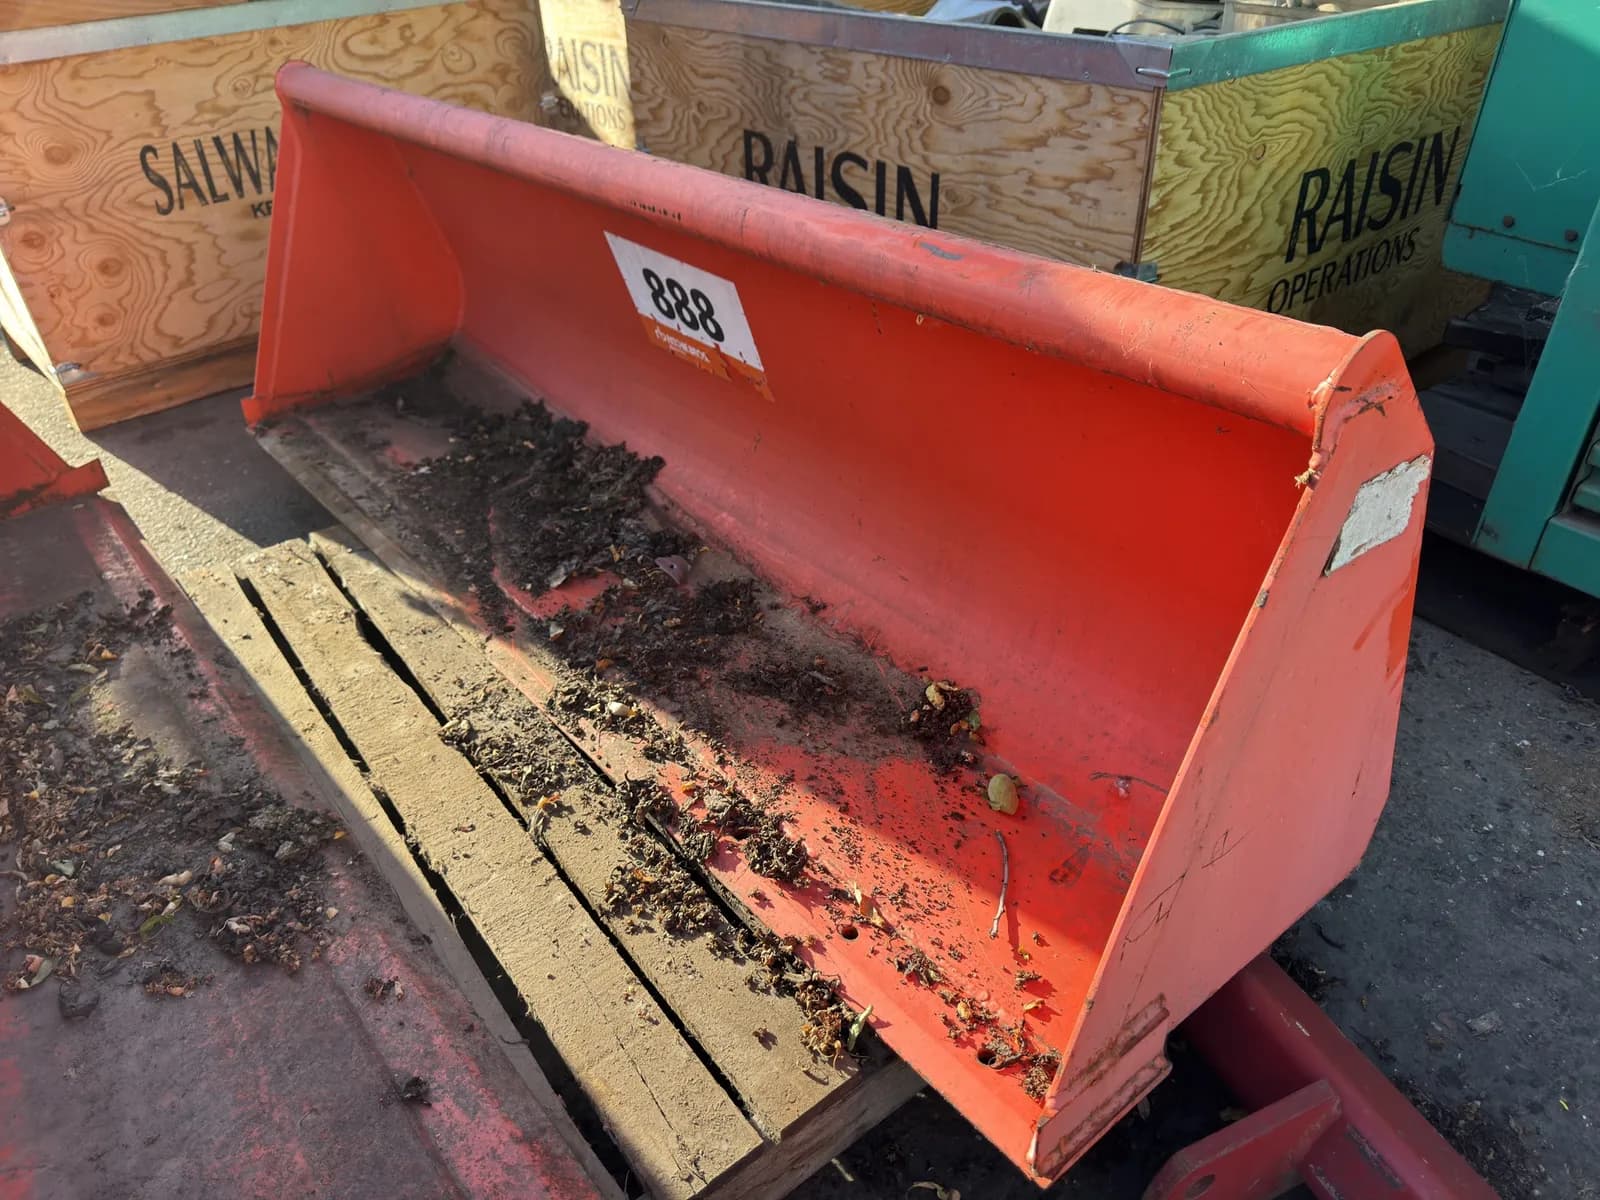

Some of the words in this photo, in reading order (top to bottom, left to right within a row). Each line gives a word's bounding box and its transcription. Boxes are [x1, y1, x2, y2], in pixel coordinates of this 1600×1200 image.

[743, 129, 940, 229] RAISIN
[1285, 126, 1460, 264] RAISIN
[642, 268, 725, 342] 888
[1267, 227, 1420, 312] OPERATIONS
